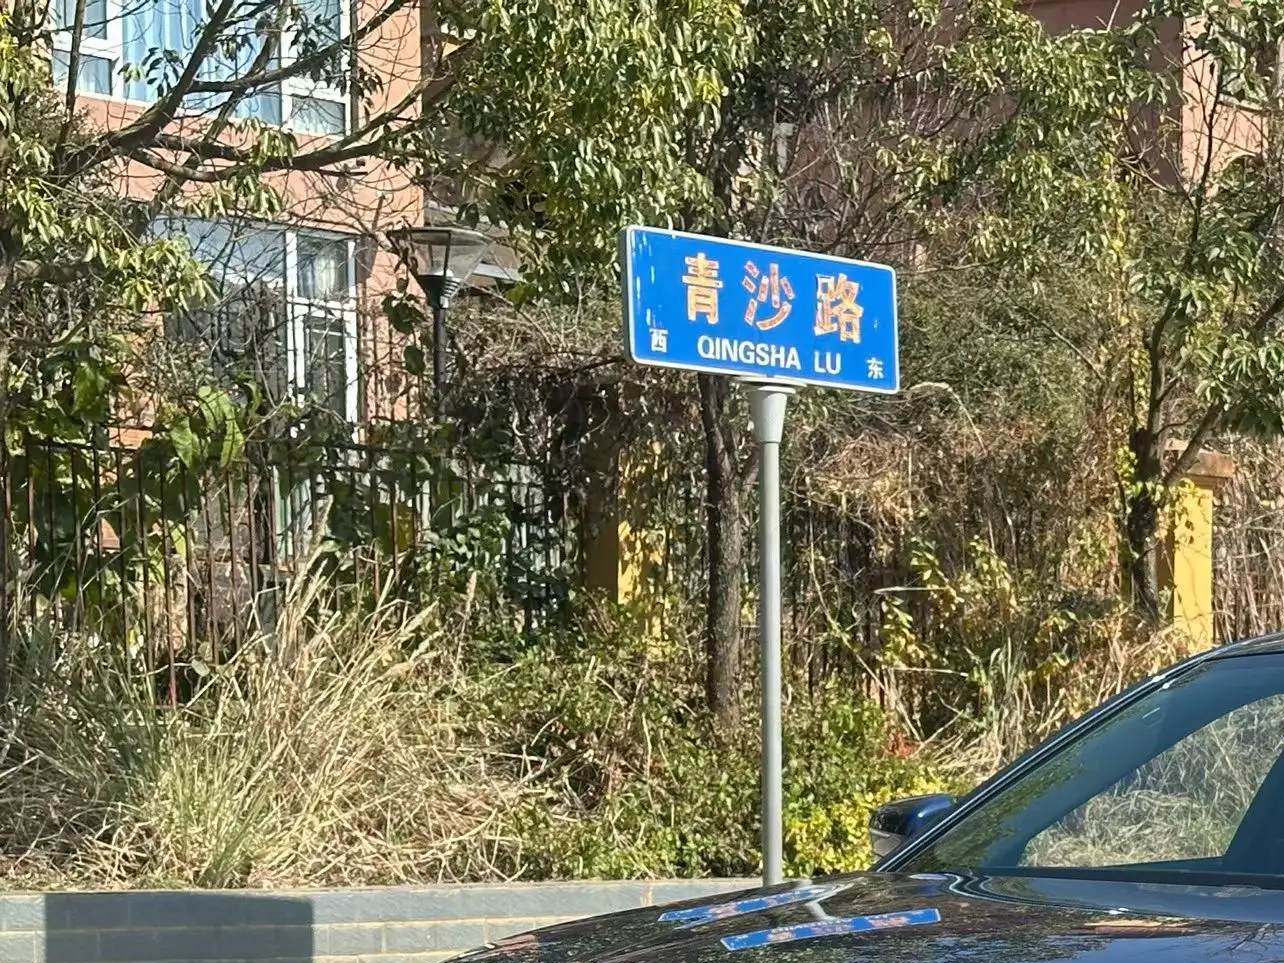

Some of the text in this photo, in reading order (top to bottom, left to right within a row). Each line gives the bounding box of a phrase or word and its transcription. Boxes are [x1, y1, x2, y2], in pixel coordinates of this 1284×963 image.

[682, 252, 864, 344] 青沙路
[649, 328, 668, 353] 西
[697, 335, 841, 375] QINGSHA LU
[866, 356, 884, 379] 东
